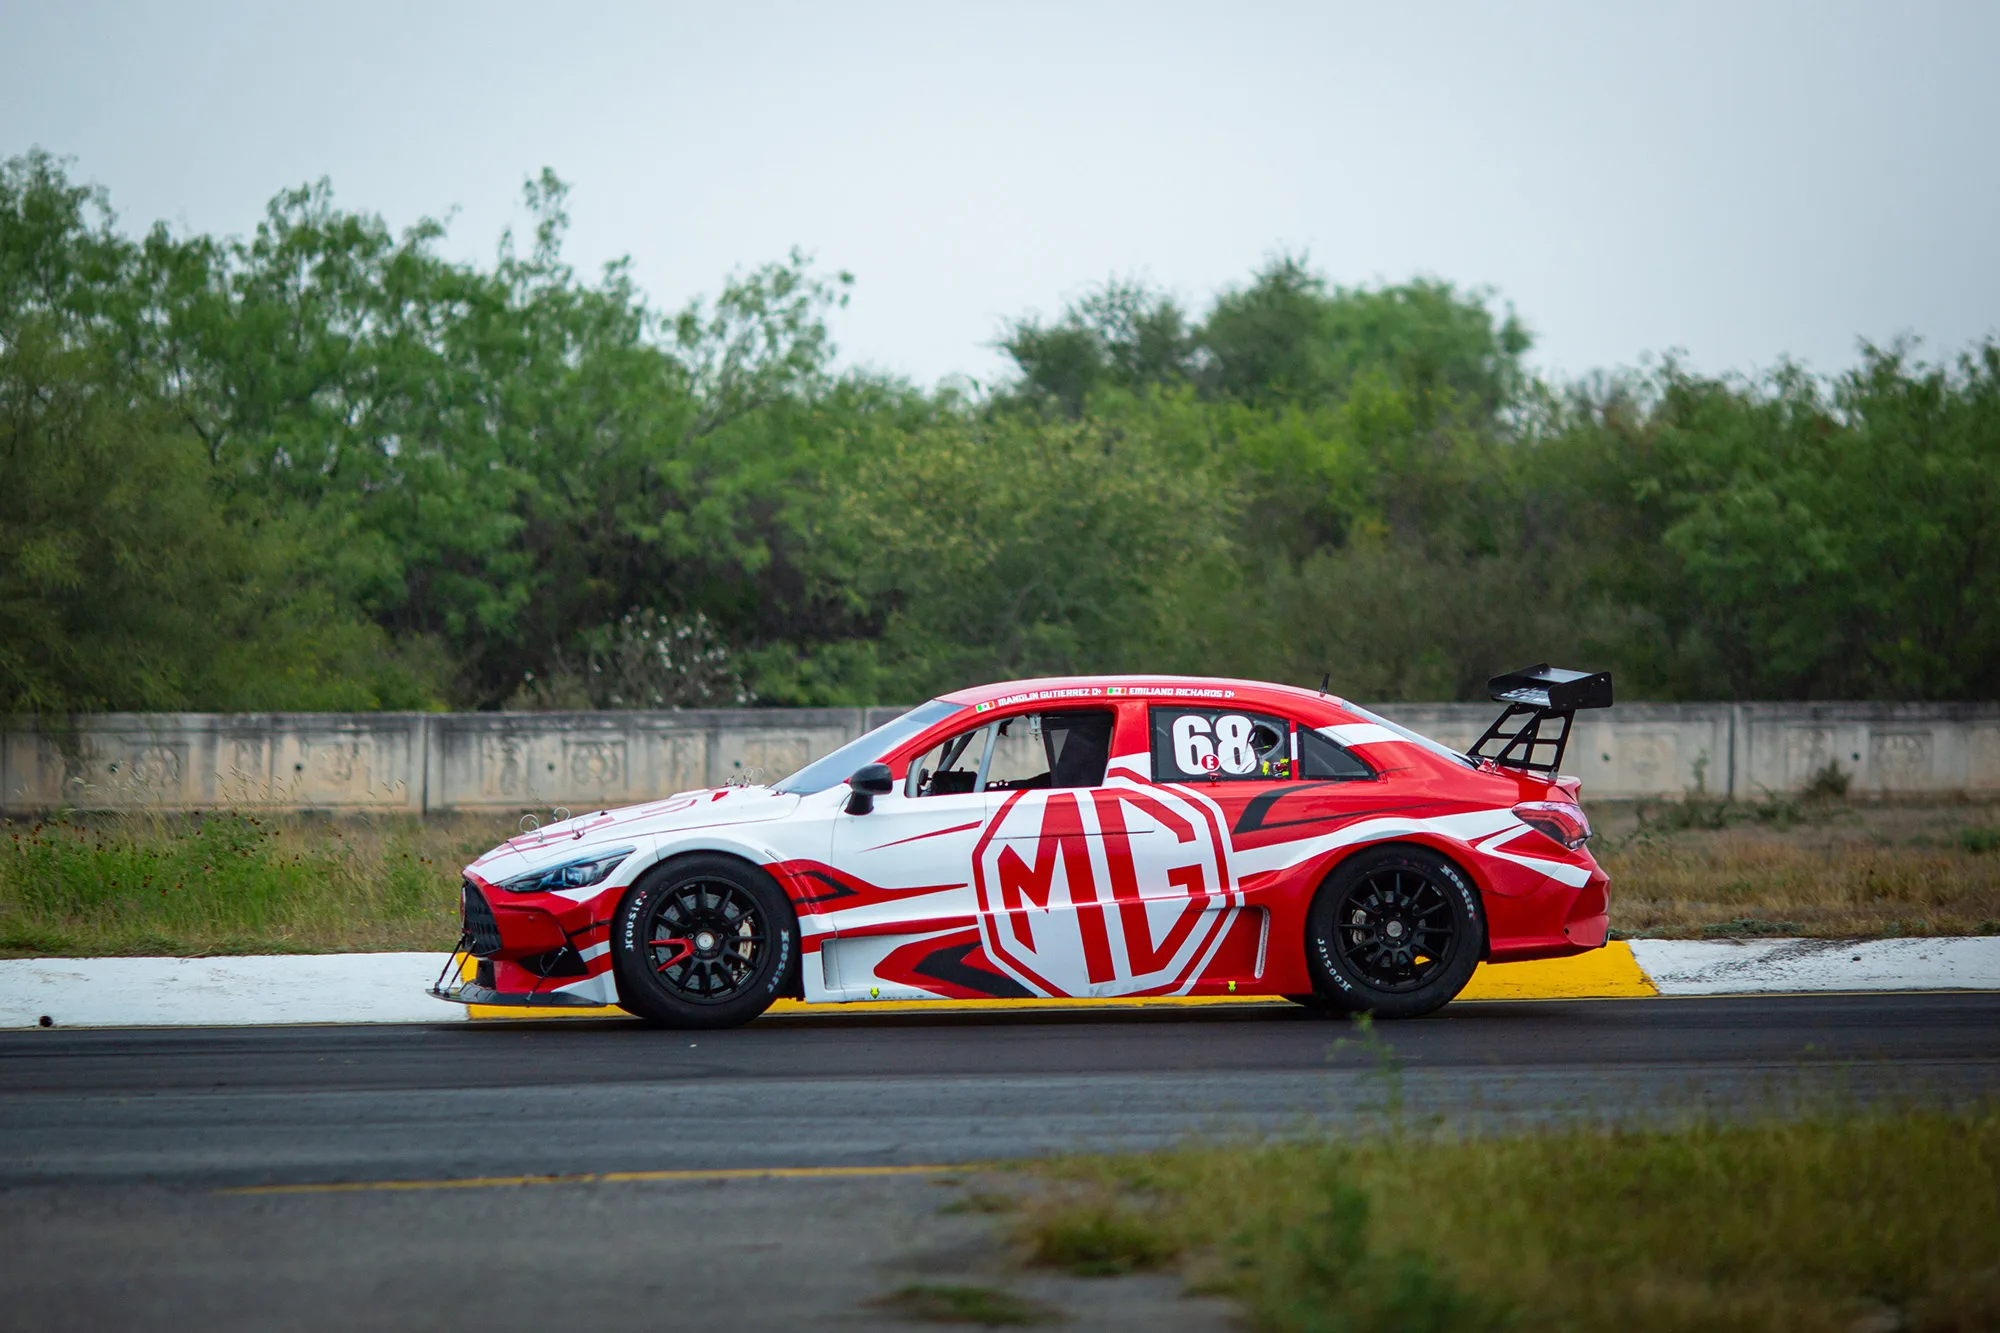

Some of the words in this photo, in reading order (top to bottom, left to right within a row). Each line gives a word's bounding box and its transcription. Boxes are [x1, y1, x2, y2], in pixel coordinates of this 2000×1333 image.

[1040, 687, 1090, 699] GUTIERREZ
[1129, 687, 1174, 696] EMILIANO
[1175, 688, 1223, 698] RICHARDS
[1172, 715, 1257, 775] 68
[1205, 755, 1215, 769] E
[997, 788, 1211, 984] MG
